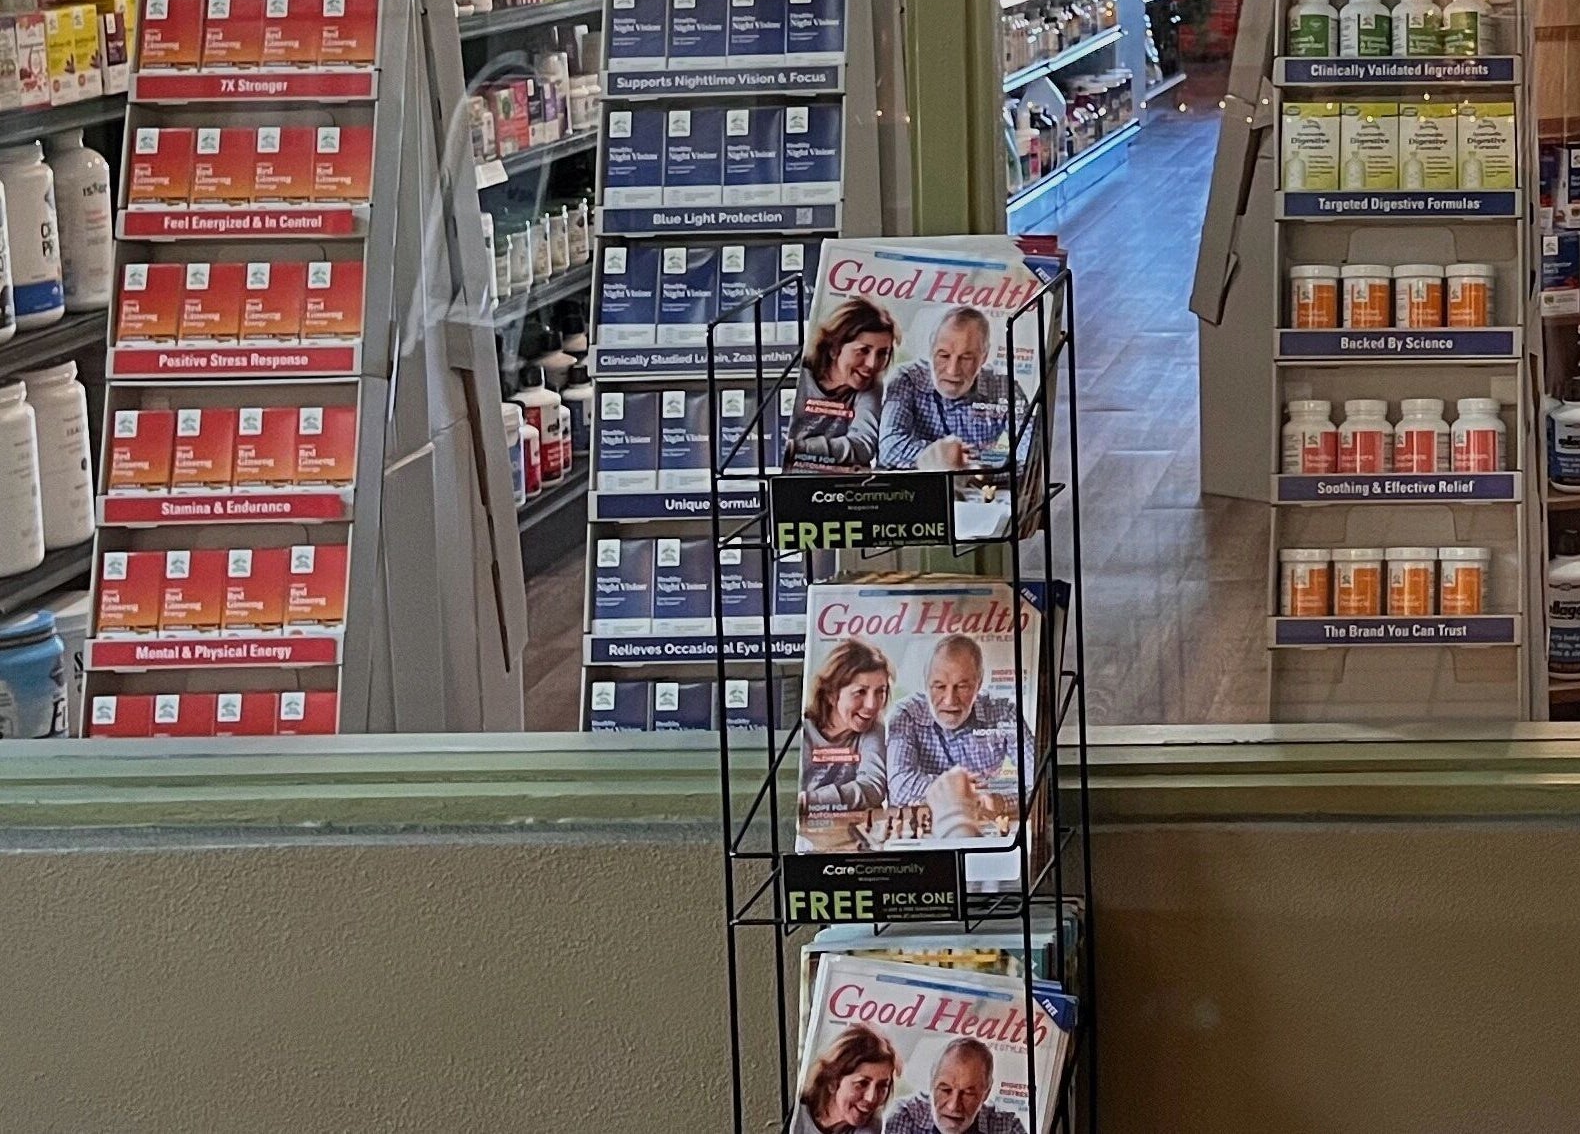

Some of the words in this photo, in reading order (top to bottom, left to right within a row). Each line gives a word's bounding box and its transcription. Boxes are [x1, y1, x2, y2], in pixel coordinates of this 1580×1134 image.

[1311, 64, 1365, 78] Clinically
[1368, 64, 1422, 76] Validated
[1425, 64, 1488, 77] Ingredients
[221, 80, 235, 92] 7X
[238, 79, 287, 94] Stronger
[617, 77, 672, 90] Supports
[675, 75, 735, 89] Nighttime
[738, 74, 775, 85] Vision
[778, 73, 787, 84] &
[790, 72, 826, 83] Focus
[1318, 198, 1368, 212] Targeted
[1371, 197, 1425, 212] Digestive
[1427, 197, 1480, 209] Formulas
[164, 217, 189, 229] Feel
[192, 217, 249, 231] Energized
[253, 216, 262, 228] &
[265, 216, 276, 228] In
[280, 215, 322, 228] Control
[653, 214, 681, 225] Blue
[684, 213, 716, 226] Light
[719, 212, 782, 224] Protection
[828, 259, 923, 300] Good
[1341, 337, 1384, 349] Backed
[1388, 337, 1403, 351] By
[1406, 337, 1453, 349] Science
[159, 354, 207, 367] Positive
[210, 354, 247, 367] Stress
[251, 354, 308, 369] Response
[600, 354, 649, 367] Clinically
[651, 353, 692, 364] Studied
[1317, 482, 1369, 495] Soothing
[1372, 482, 1381, 493] &
[1385, 481, 1436, 493] Effective
[1439, 481, 1474, 493] Relief
[161, 502, 211, 515] Stamina
[214, 501, 224, 513] &
[227, 501, 291, 513] Endurance
[665, 499, 710, 511] Unique
[873, 524, 907, 538] PICK
[912, 523, 944, 536] ONE
[818, 603, 909, 636] Good
[1324, 625, 1346, 637] The
[1350, 625, 1384, 637] Brand
[1387, 625, 1409, 637] You
[1412, 624, 1435, 636] Can
[1438, 624, 1467, 636] Trust
[136, 646, 179, 660] Mental
[182, 645, 192, 659] &
[194, 644, 247, 661] Physical
[250, 643, 291, 660] Energy
[609, 643, 662, 656] Relieves
[736, 641, 759, 654] Eye
[788, 891, 874, 920] FREE
[883, 893, 917, 905] PICK
[921, 892, 954, 904] ONE
[829, 984, 925, 1028] Good
